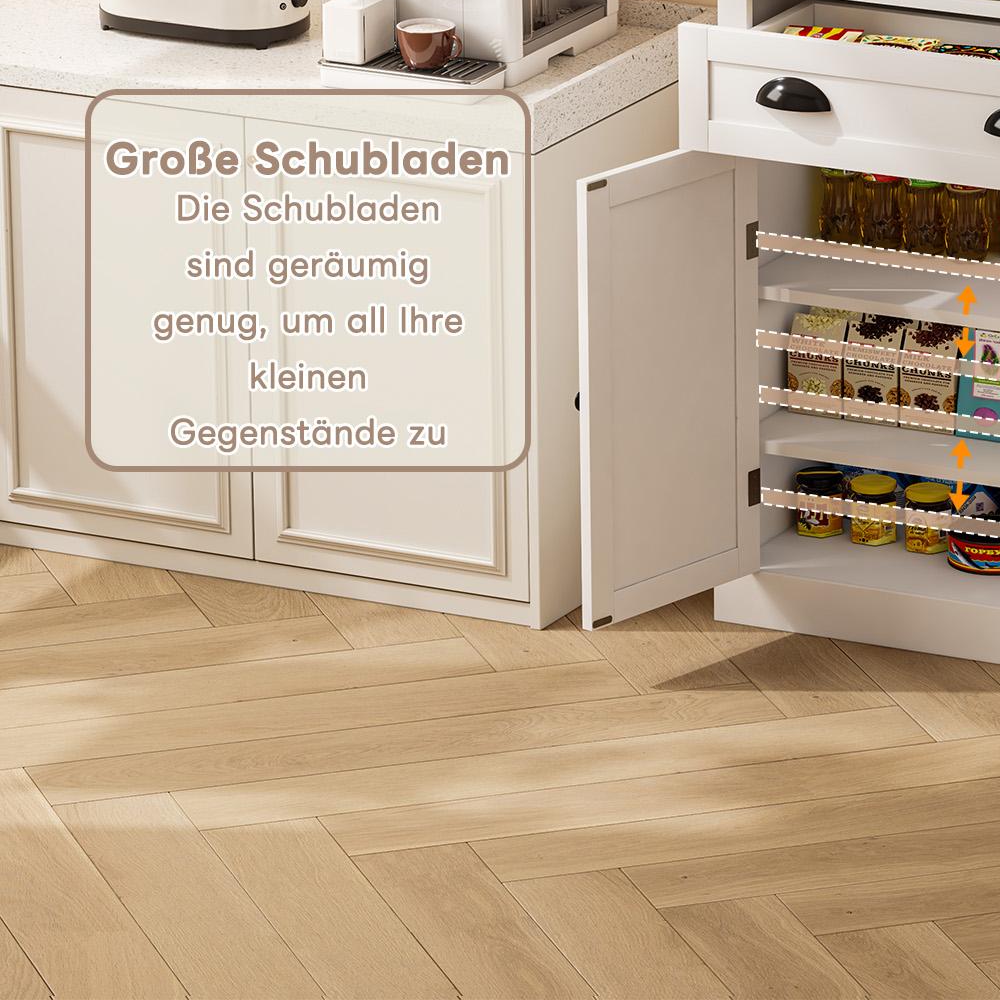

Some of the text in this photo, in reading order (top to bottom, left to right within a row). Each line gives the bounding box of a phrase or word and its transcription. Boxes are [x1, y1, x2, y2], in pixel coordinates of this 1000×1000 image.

[789, 351, 839, 363] CHUNKS
[845, 359, 895, 371] CHUNKS
[902, 367, 951, 379] CHUNKS
